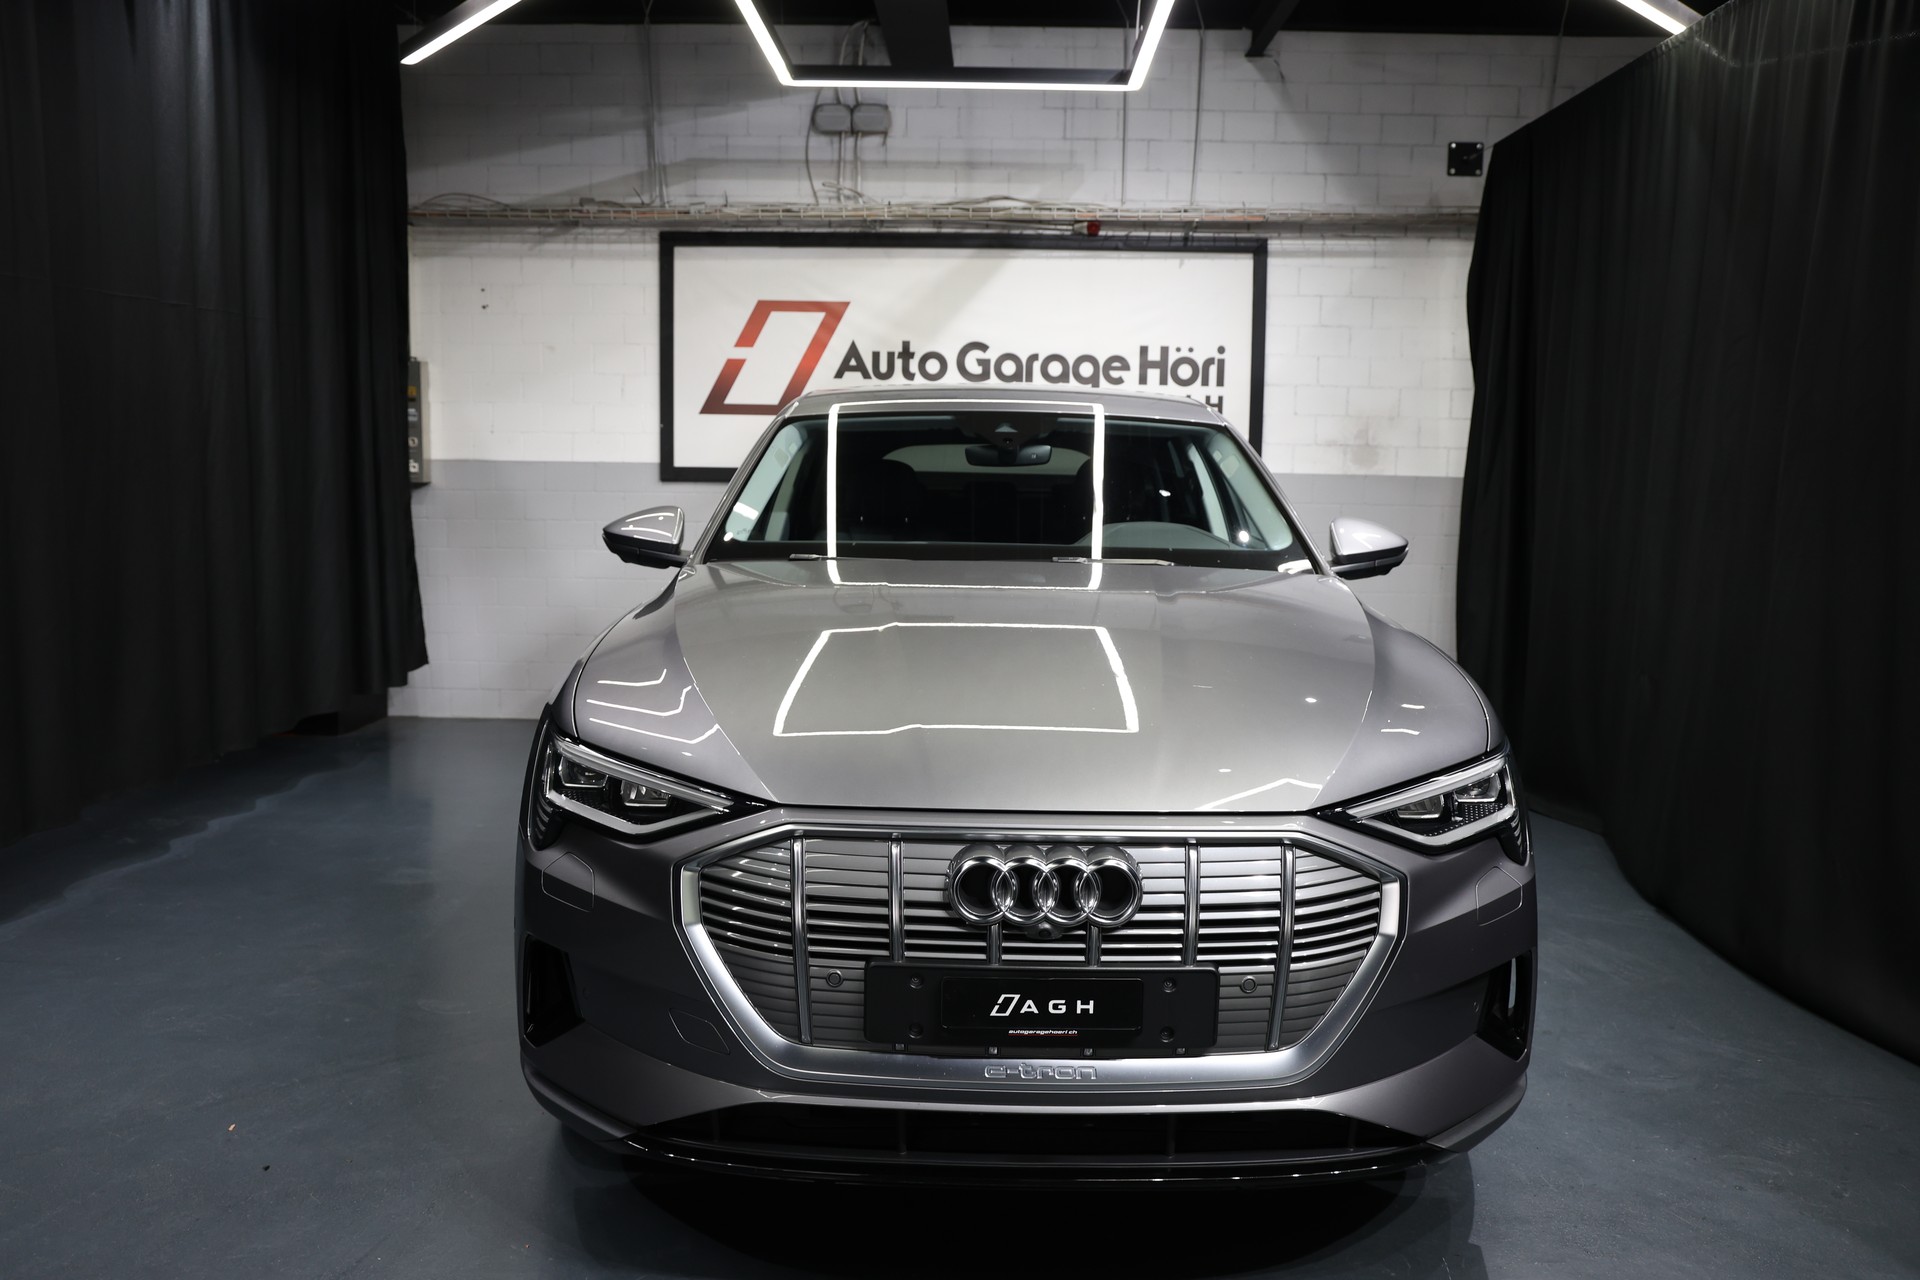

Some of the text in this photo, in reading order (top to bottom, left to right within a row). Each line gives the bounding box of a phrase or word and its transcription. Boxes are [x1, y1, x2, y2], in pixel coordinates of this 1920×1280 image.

[834, 340, 1225, 388] Auto Garage Höri
[1020, 999, 1094, 1014] AGH
[984, 1062, 1097, 1080] e-tron
